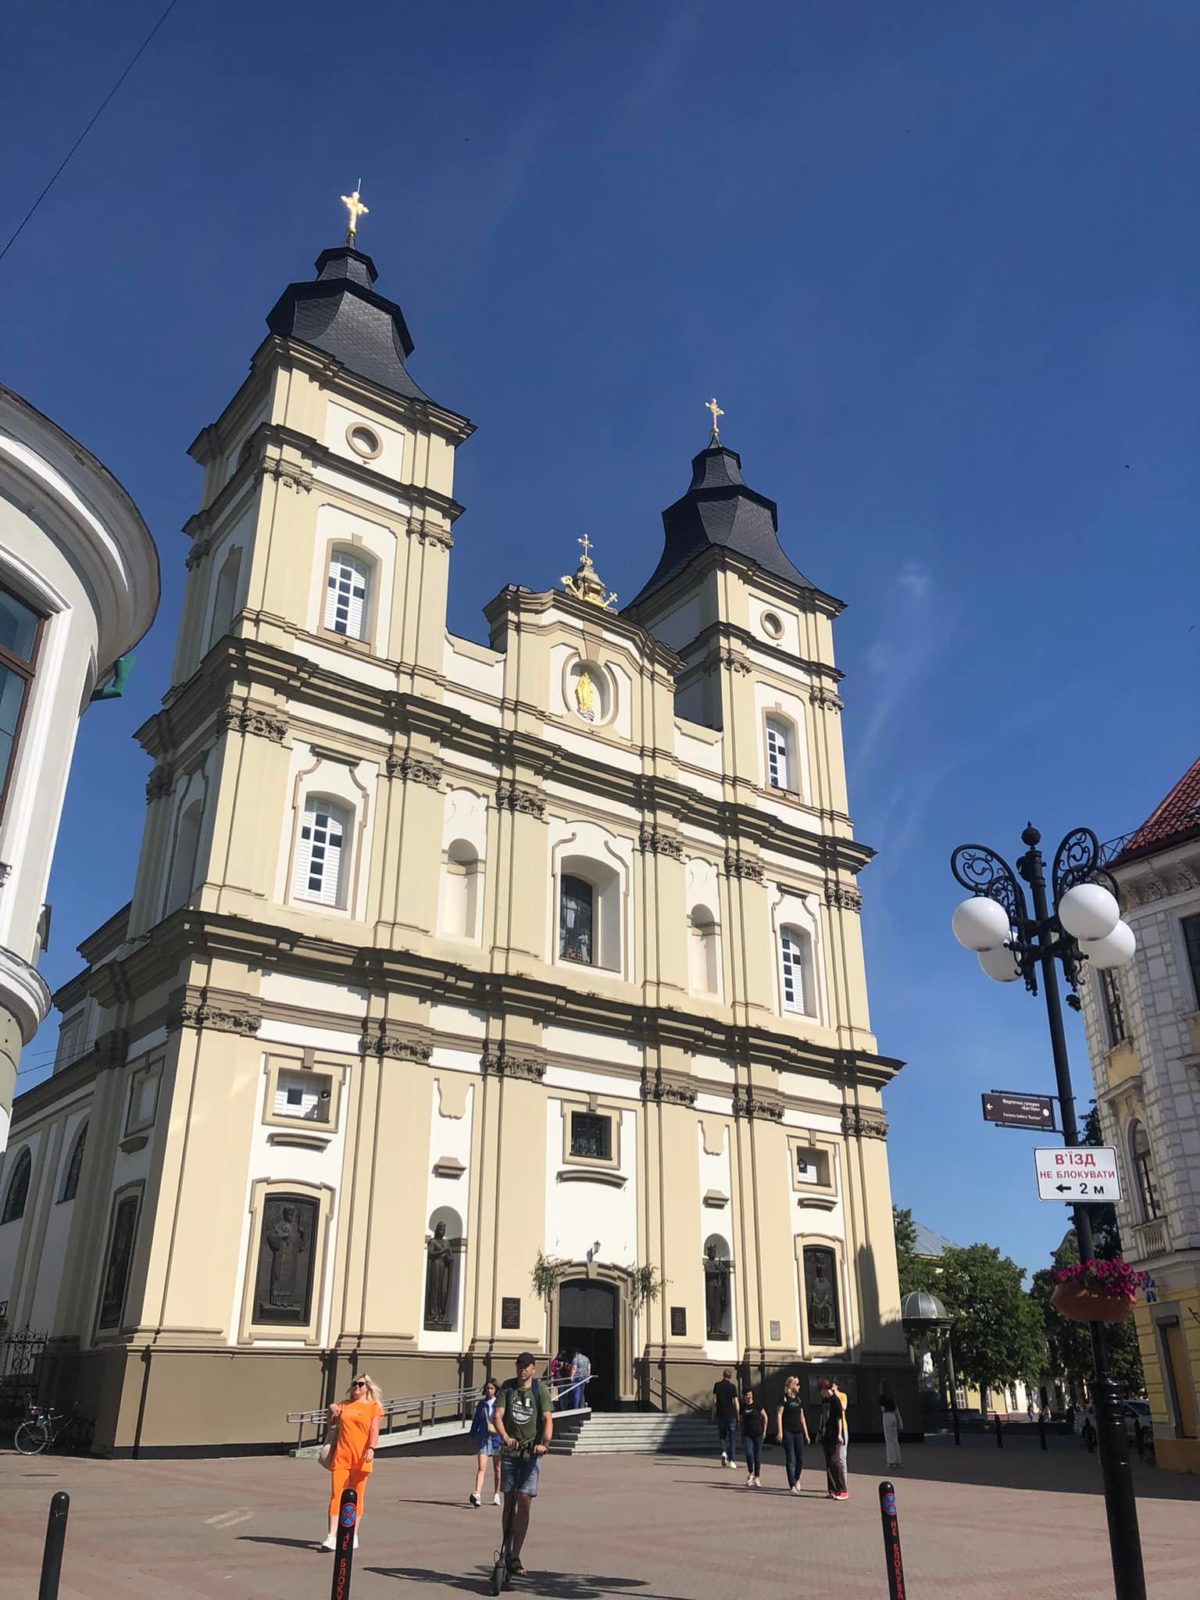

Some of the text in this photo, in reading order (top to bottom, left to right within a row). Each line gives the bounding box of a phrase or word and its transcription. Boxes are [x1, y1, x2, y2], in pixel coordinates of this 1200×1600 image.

[1055, 1151, 1096, 1167] В'ЇЗД
[1040, 1170, 1116, 1179] НЕ БЛОКУВАТИ
[1079, 1182, 1088, 1194] 2
